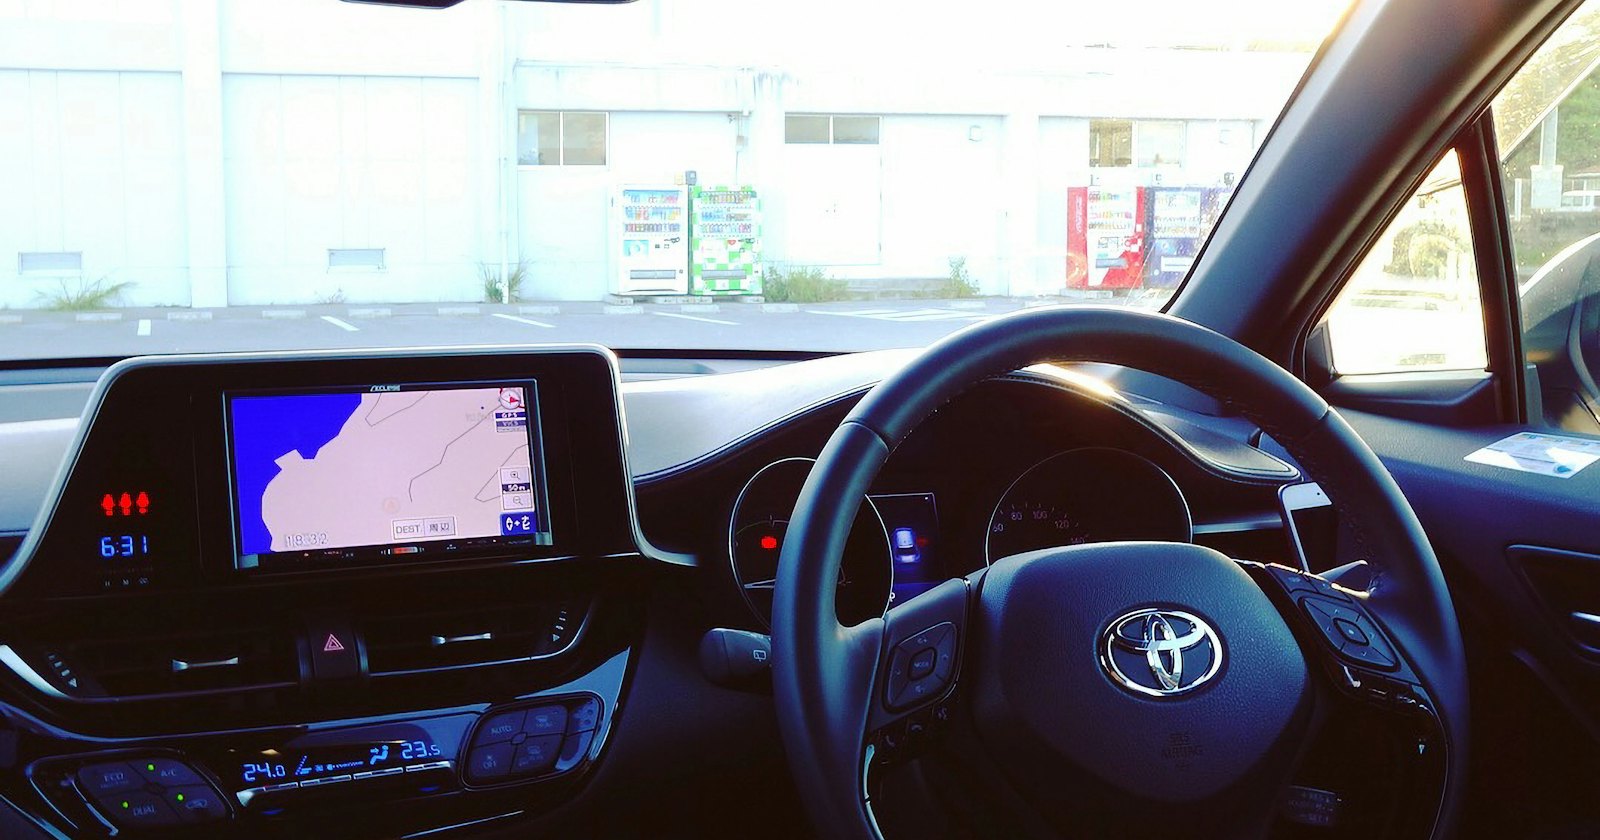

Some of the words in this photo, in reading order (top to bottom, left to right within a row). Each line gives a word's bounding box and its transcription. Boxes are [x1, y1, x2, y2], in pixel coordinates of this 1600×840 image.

[1032, 510, 1048, 519] 100
[1055, 520, 1070, 529] 120
[101, 535, 148, 557] 6:31
[401, 740, 440, 761] 23.5
[243, 762, 286, 783] 24.0
